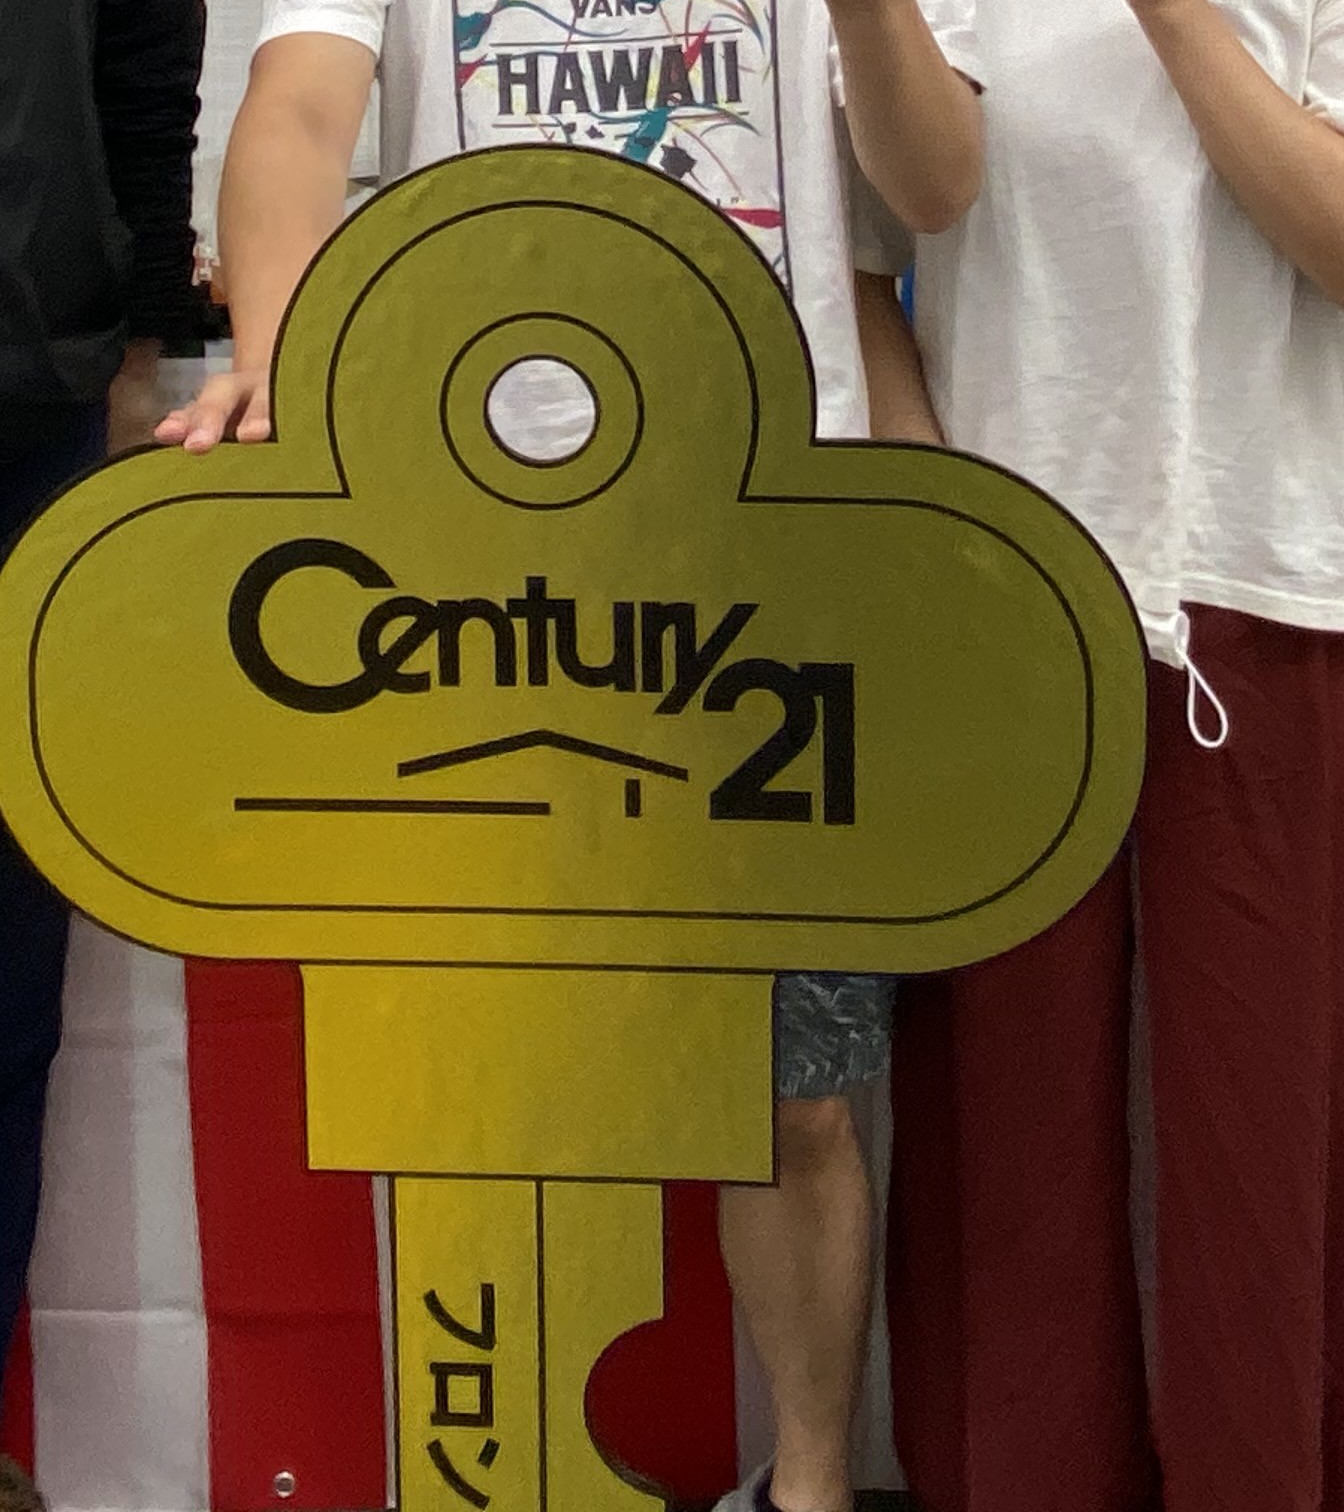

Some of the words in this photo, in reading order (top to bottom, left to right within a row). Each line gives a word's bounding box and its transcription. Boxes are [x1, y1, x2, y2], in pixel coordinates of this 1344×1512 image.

[495, 38, 742, 116] HAWAII
[227, 537, 760, 715] Century
[702, 656, 856, 826] 21
